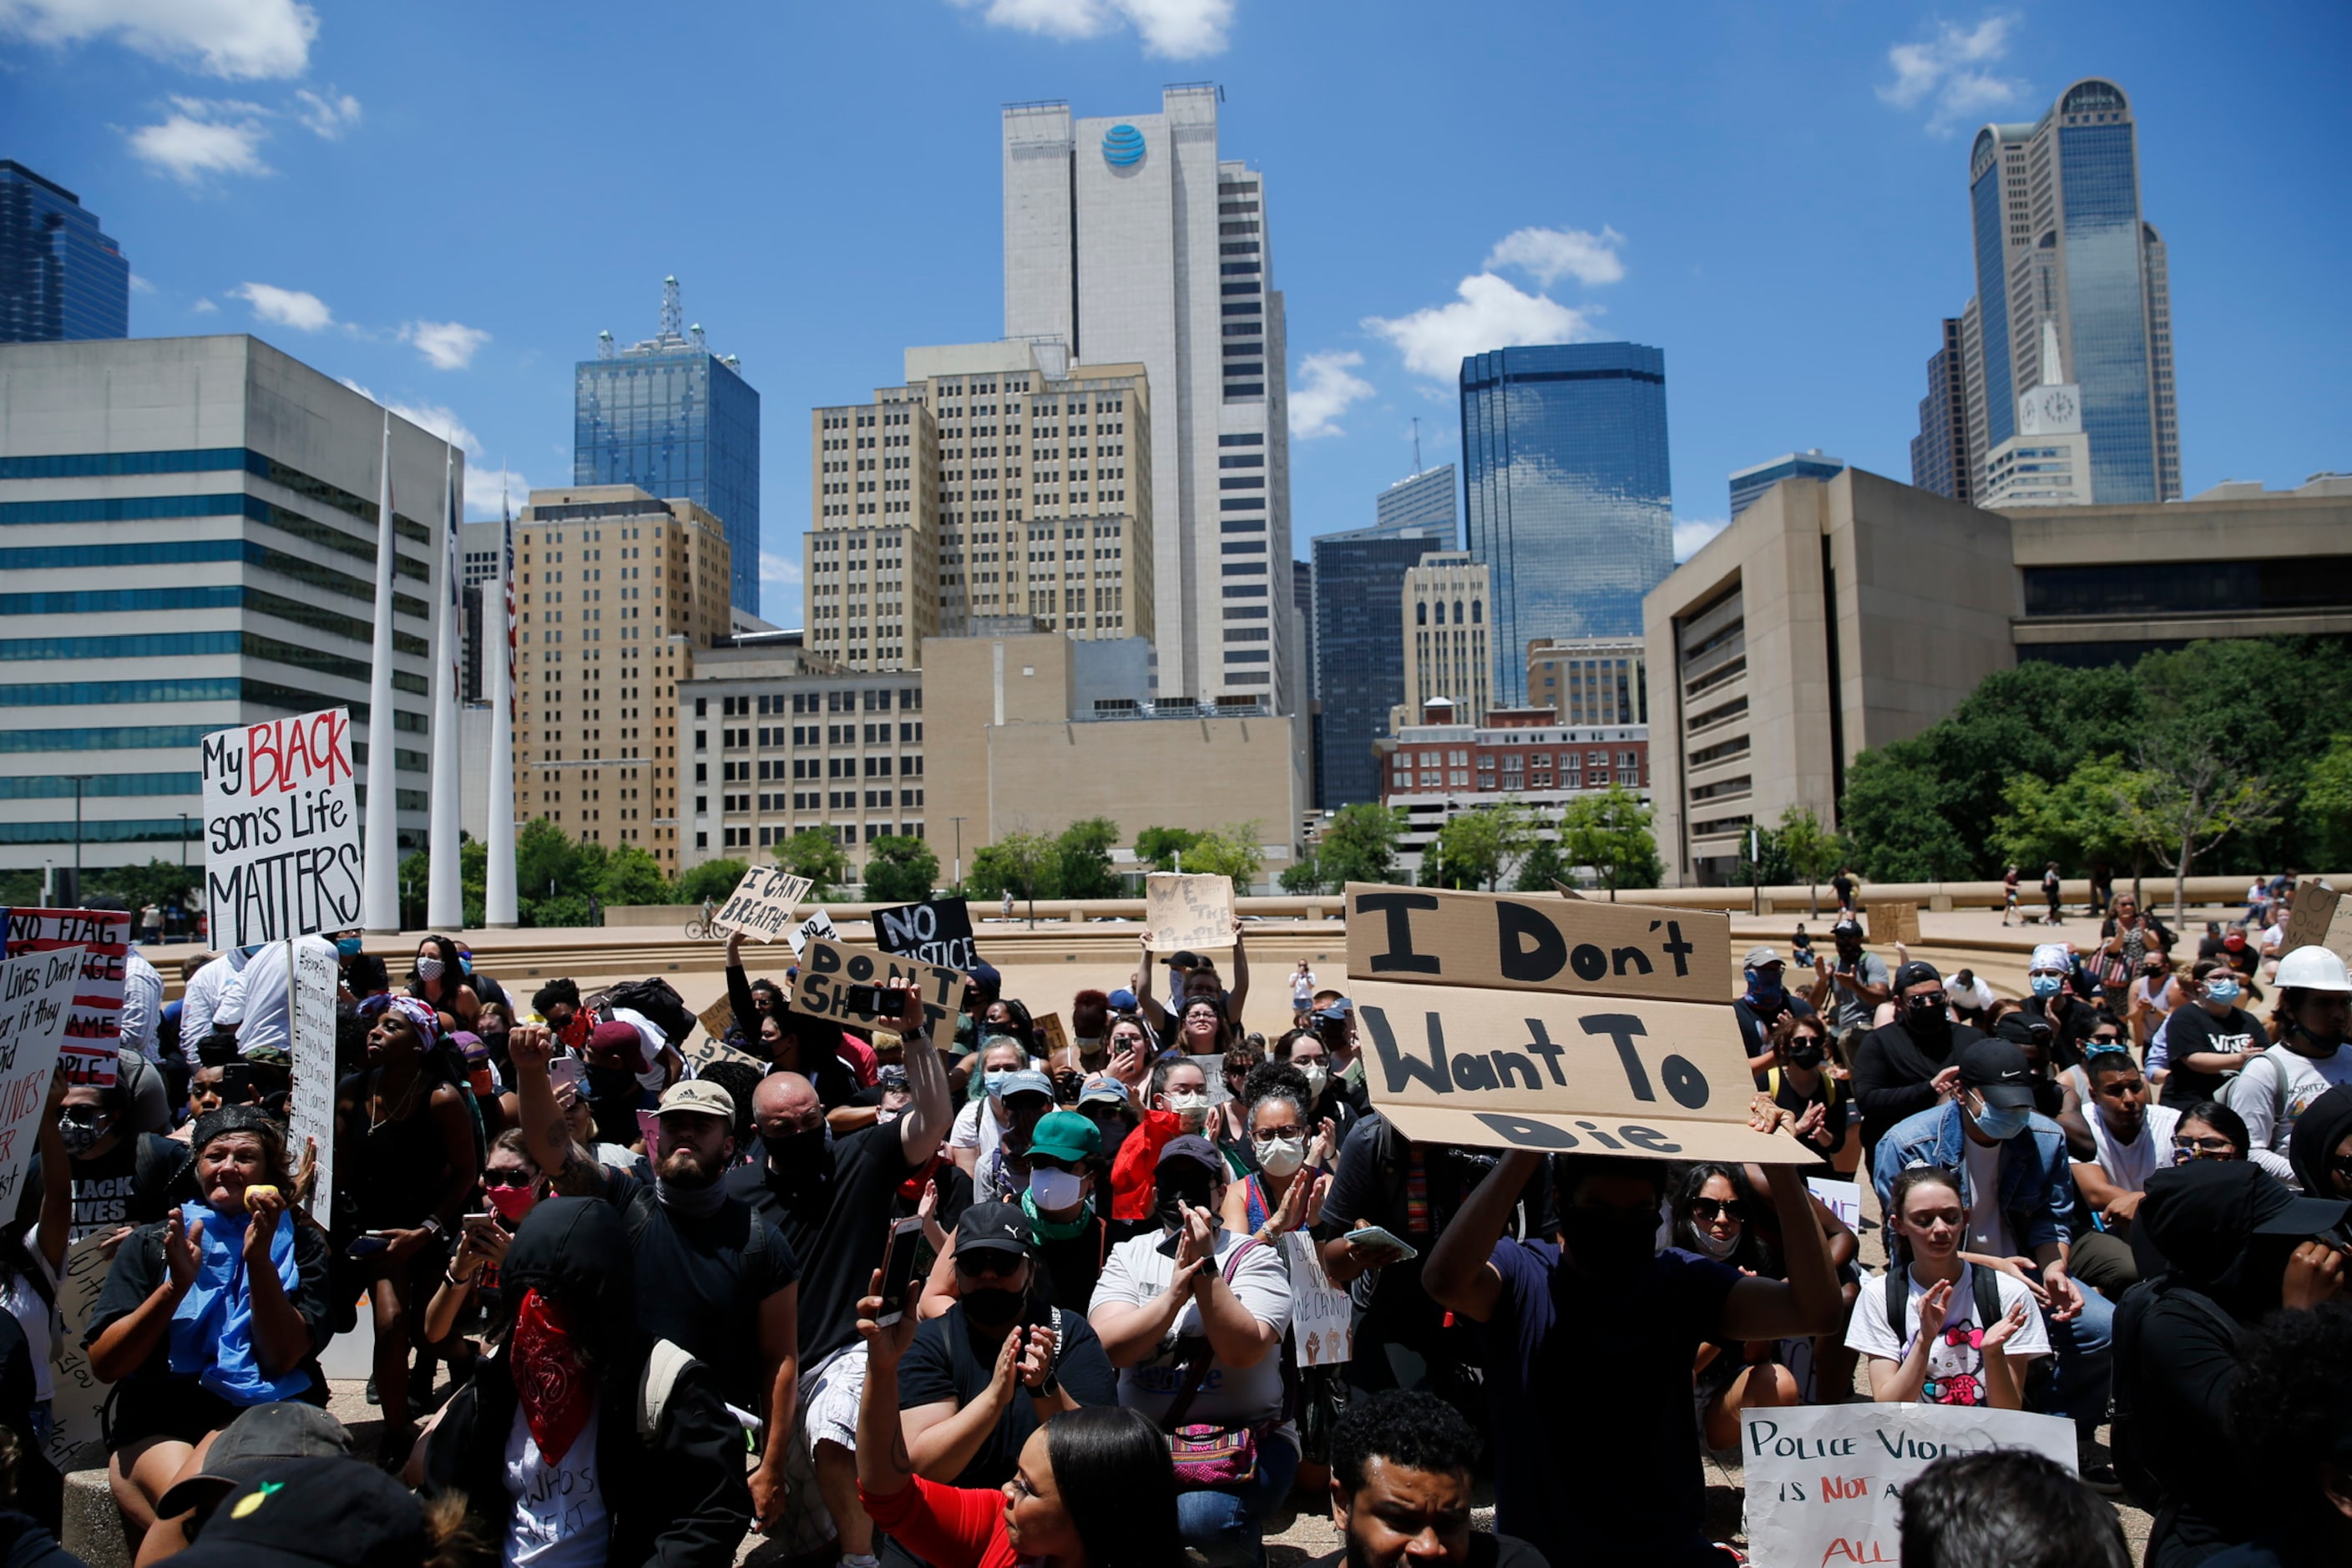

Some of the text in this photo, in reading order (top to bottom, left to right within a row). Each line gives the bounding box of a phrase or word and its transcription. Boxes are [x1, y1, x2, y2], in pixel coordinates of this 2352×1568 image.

[202, 710, 353, 797] My BLACK
[209, 788, 348, 855] son's Life
[209, 842, 362, 952] MATTERS
[742, 868, 766, 890] I
[1149, 878, 1198, 905] WE
[7, 915, 42, 941] NO
[720, 896, 790, 934] BREATHE
[801, 920, 818, 940] NO
[881, 904, 937, 947] NO
[1355, 893, 1693, 982] I Don't
[811, 943, 959, 1005] DON'T
[66, 1013, 116, 1039] AME
[801, 974, 947, 1044] SHT
[1359, 1005, 1710, 1110] Want To
[1472, 1112, 1683, 1153] Die
[70, 1175, 134, 1200] LACK
[70, 1199, 127, 1223] IVES
[1748, 1419, 1954, 1460] POLICE VIOL
[1820, 1475, 1877, 1504] NOT
